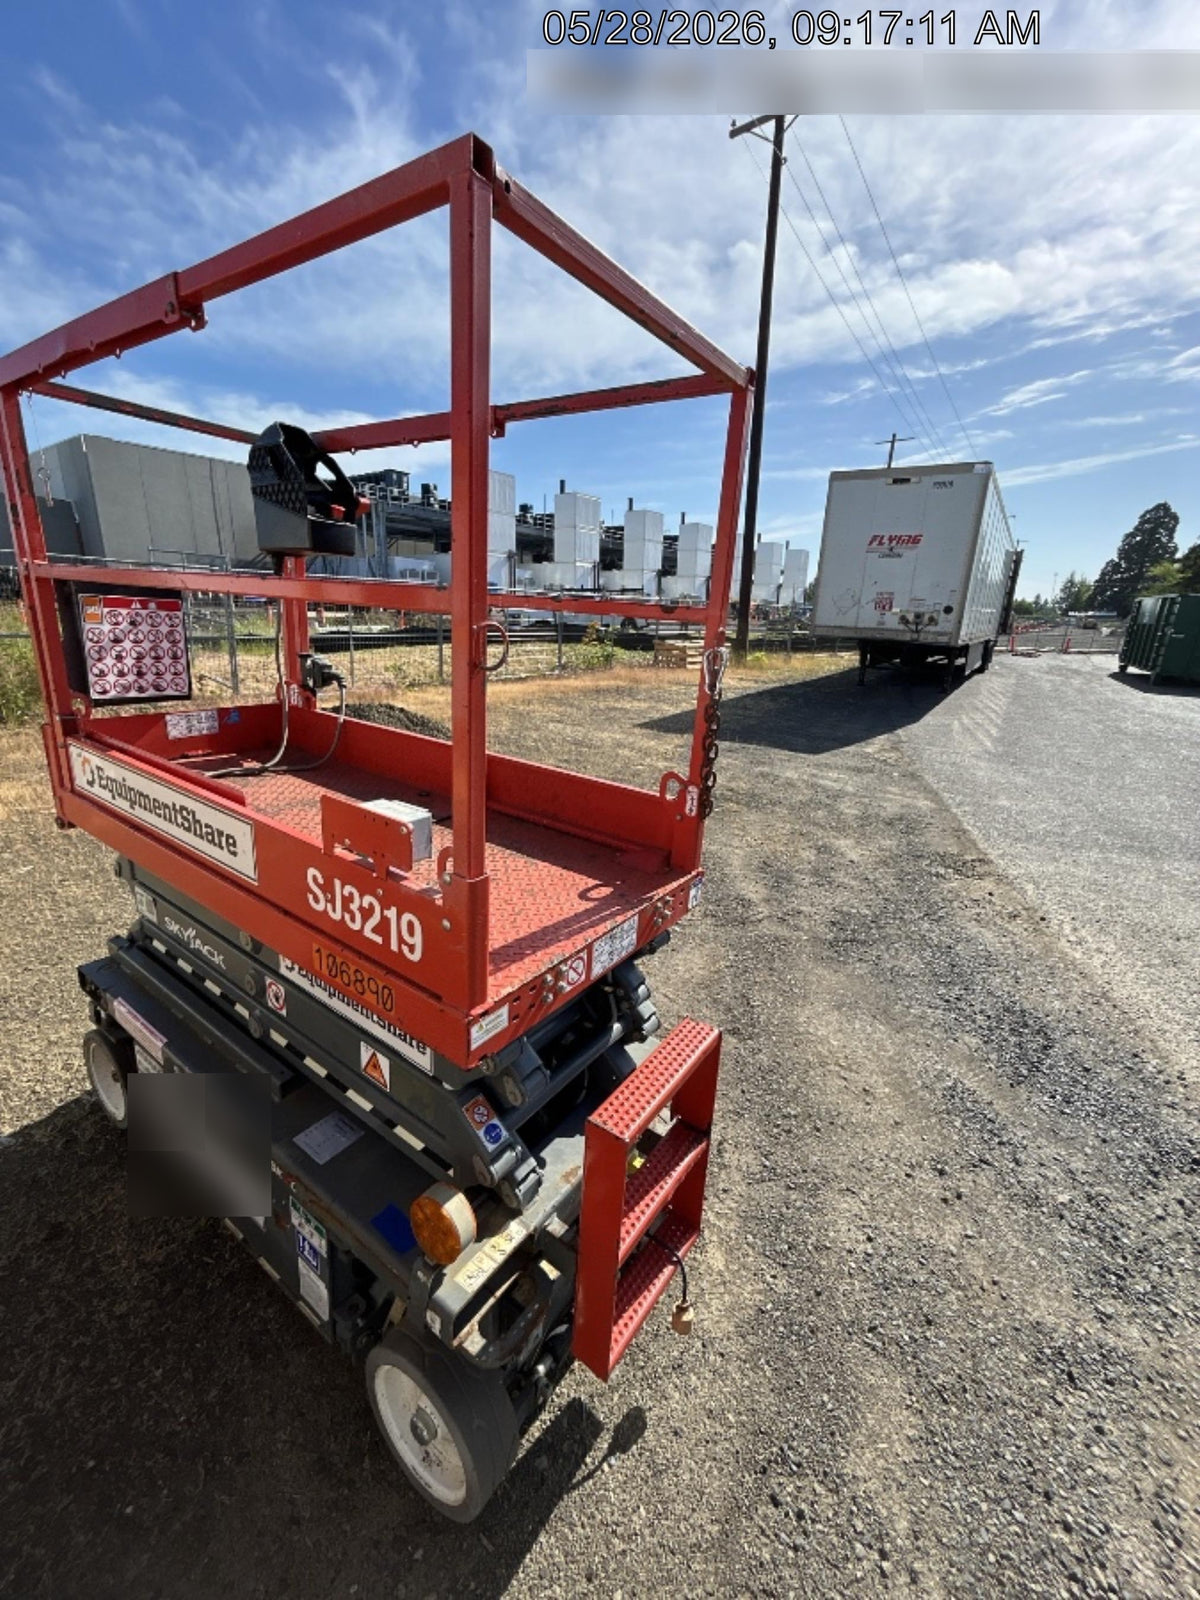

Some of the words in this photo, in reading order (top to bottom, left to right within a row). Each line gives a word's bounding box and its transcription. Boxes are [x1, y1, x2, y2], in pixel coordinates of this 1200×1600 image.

[868, 534, 924, 546] FLYING
[95, 764, 238, 857] EquipmentShare
[307, 867, 423, 962] SJ3219
[315, 946, 394, 1012] 106890
